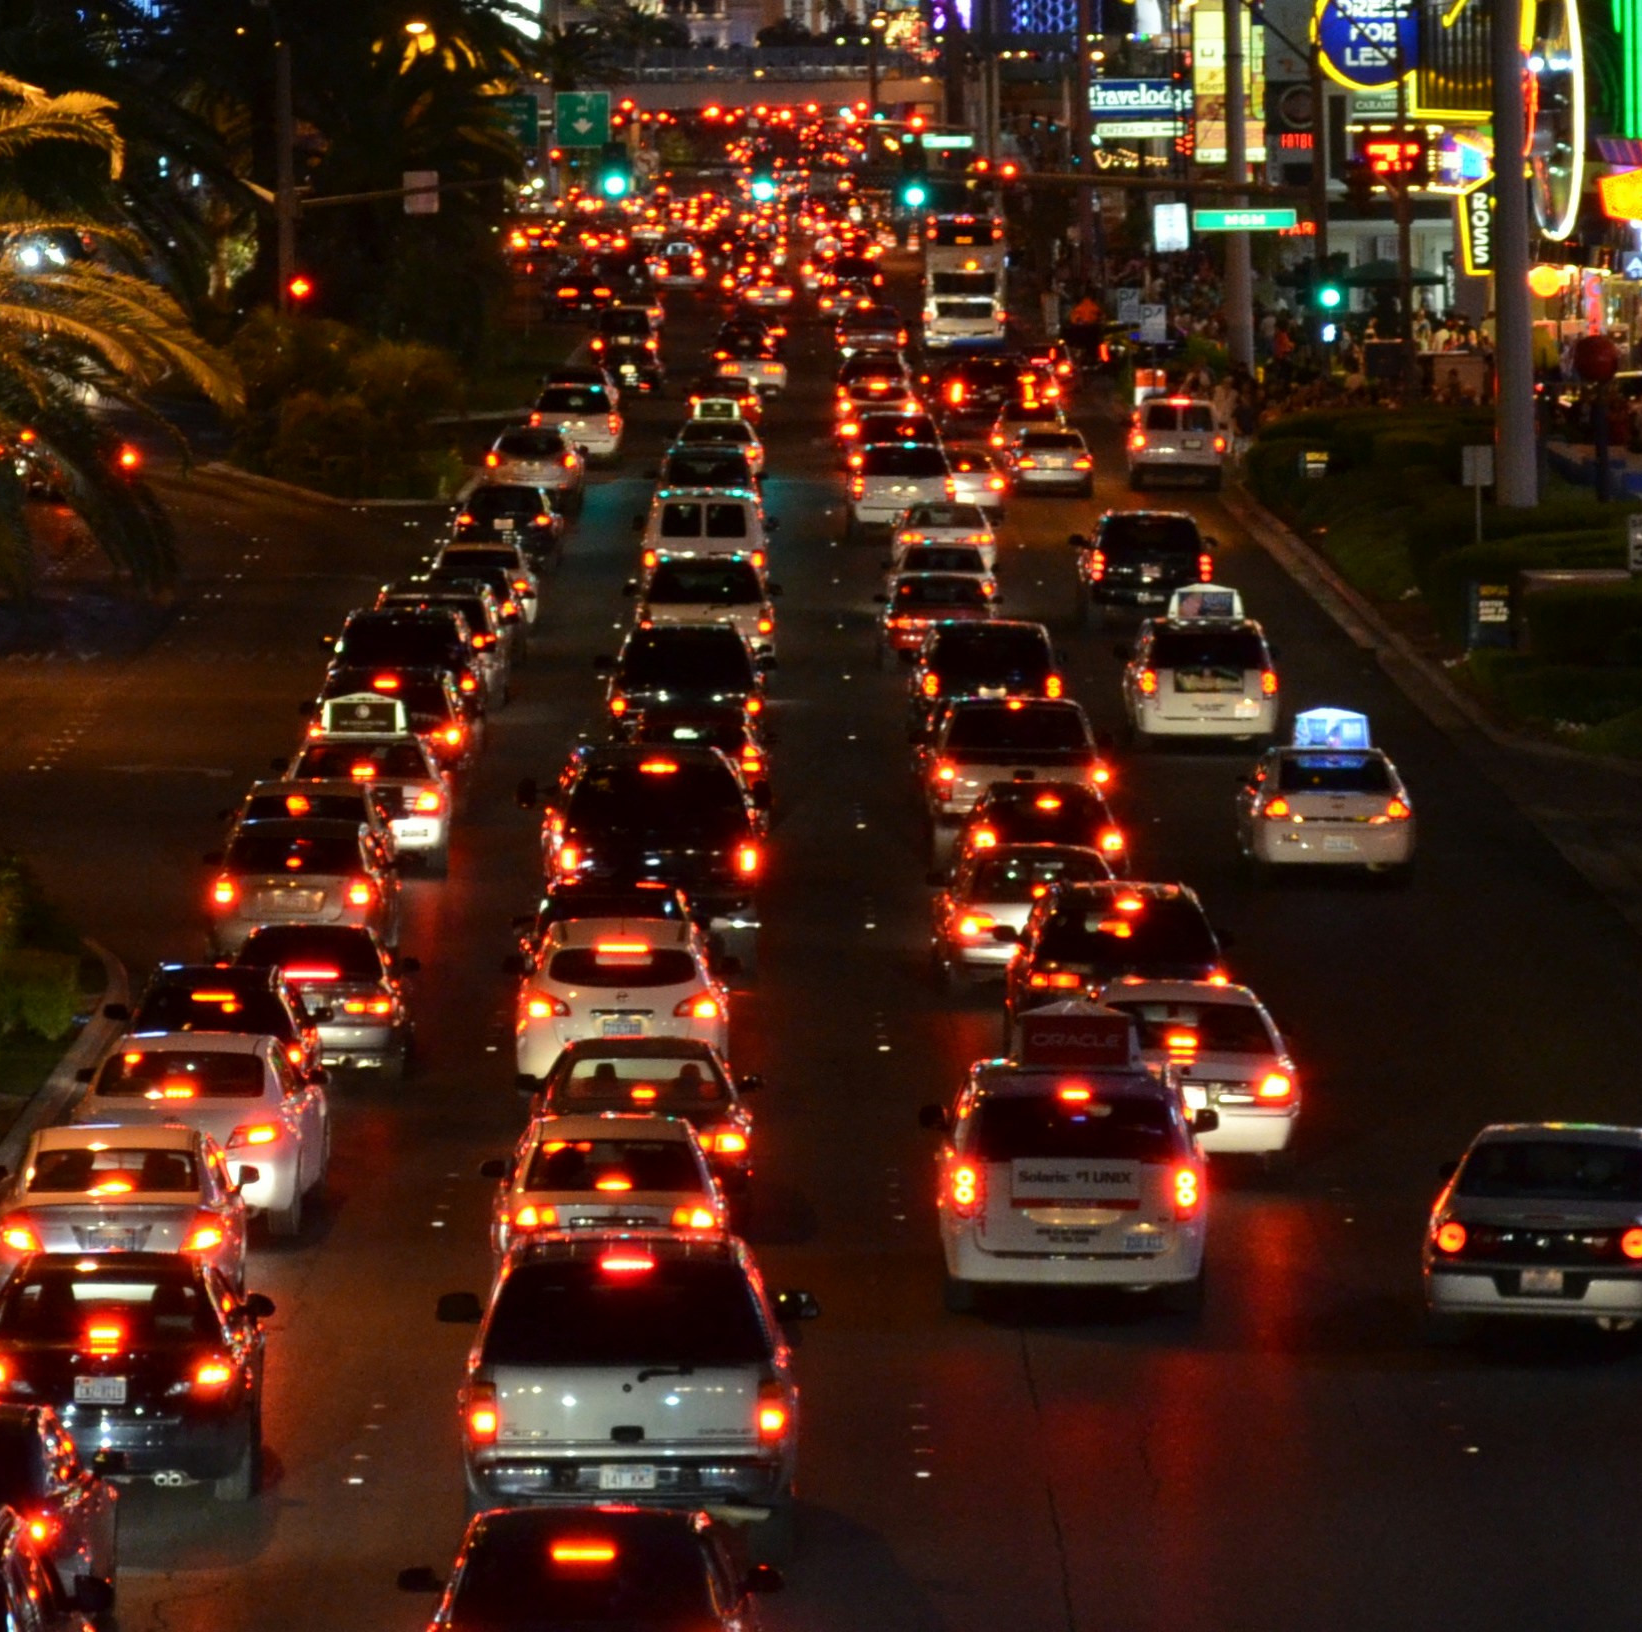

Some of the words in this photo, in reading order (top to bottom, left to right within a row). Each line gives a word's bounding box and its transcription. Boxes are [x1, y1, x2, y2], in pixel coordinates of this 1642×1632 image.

[1349, 22, 1398, 43] FOR
[1471, 191, 1490, 265] ROSS
[1031, 1032, 1121, 1048] ORACLE
[1093, 1170, 1132, 1185] UNIX
